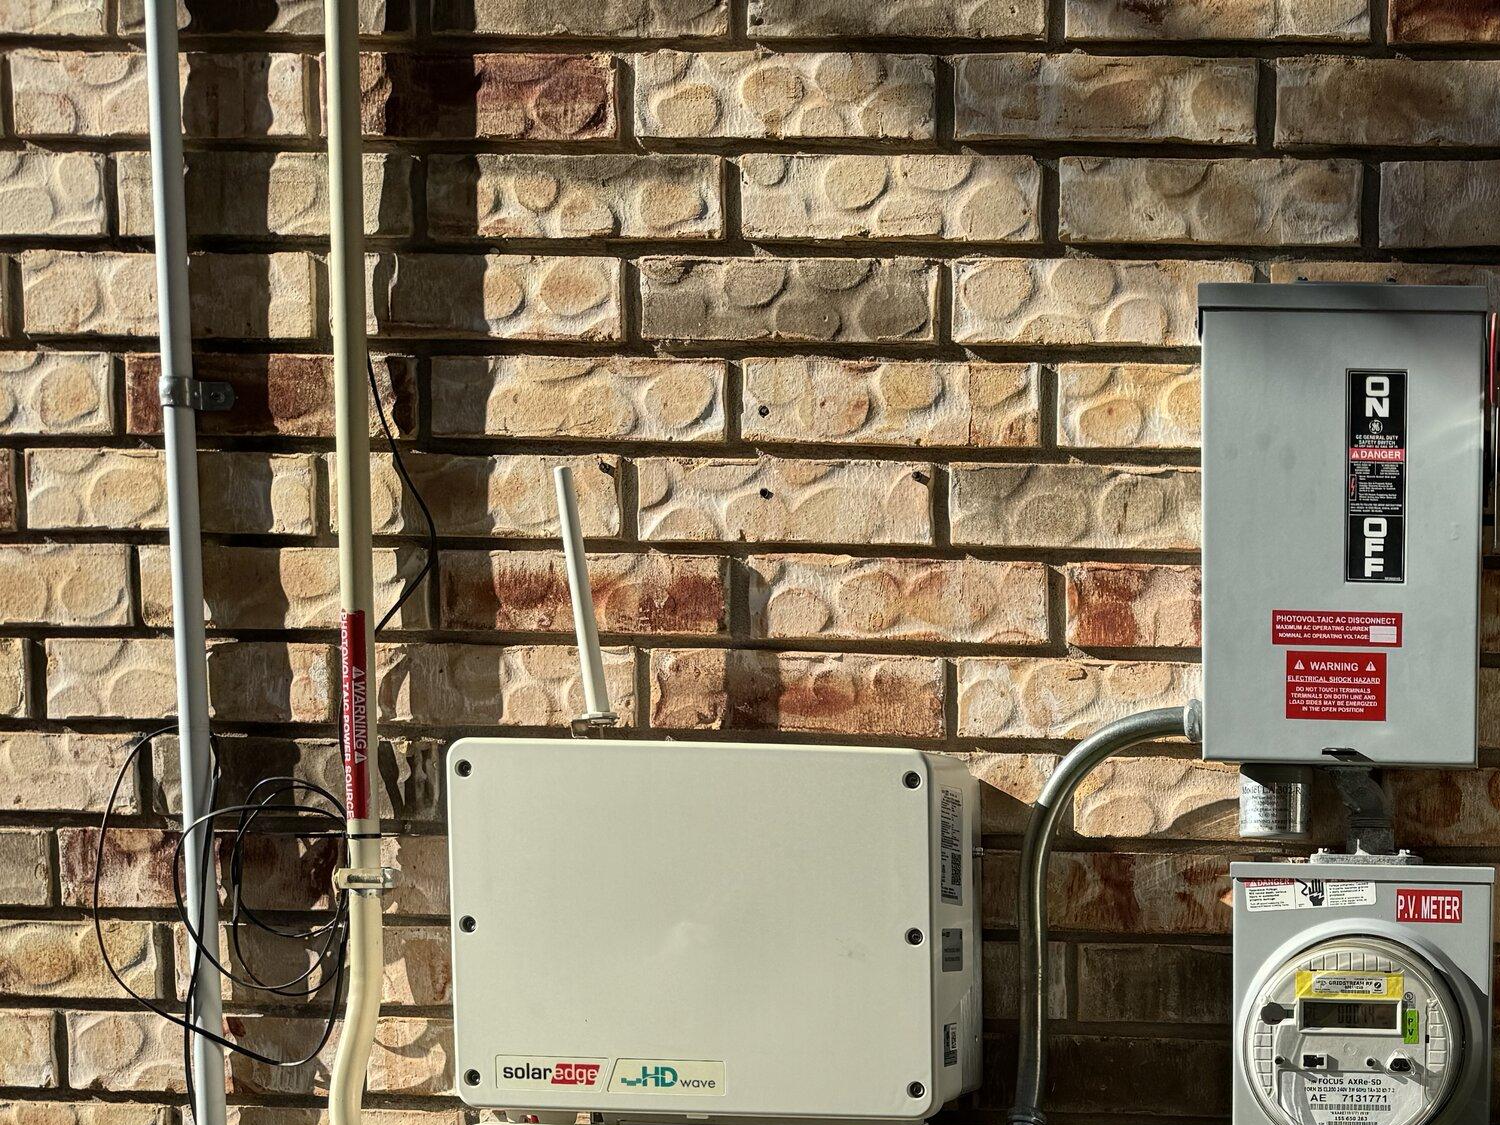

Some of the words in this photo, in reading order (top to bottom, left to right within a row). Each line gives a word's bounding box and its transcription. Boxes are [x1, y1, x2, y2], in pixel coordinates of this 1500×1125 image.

[1365, 376, 1390, 418] ON
[1360, 450, 1401, 459] DANGER
[1363, 517, 1388, 578] OFF
[1276, 614, 1334, 624] PHOTOVOLTAIC
[1335, 616, 1347, 624] AC
[1348, 616, 1396, 625] DISCONNECT
[340, 612, 350, 711] PHOTOVOLTAIC
[1309, 661, 1359, 672] WARNING
[1287, 675, 1327, 684] ELECTRICAL
[1329, 676, 1352, 685] SHOCK
[1353, 677, 1381, 685] HAZARD
[352, 681, 367, 750] WARNING
[342, 713, 352, 765] POWER
[344, 766, 355, 820] SOURCE
[1397, 894, 1418, 919] P.V.
[1421, 895, 1460, 920] METER
[641, 1065, 678, 1088] HD
[680, 1078, 716, 1089] wave
[1310, 1093, 1327, 1102] AE
[1342, 1094, 1387, 1103] 7131771
